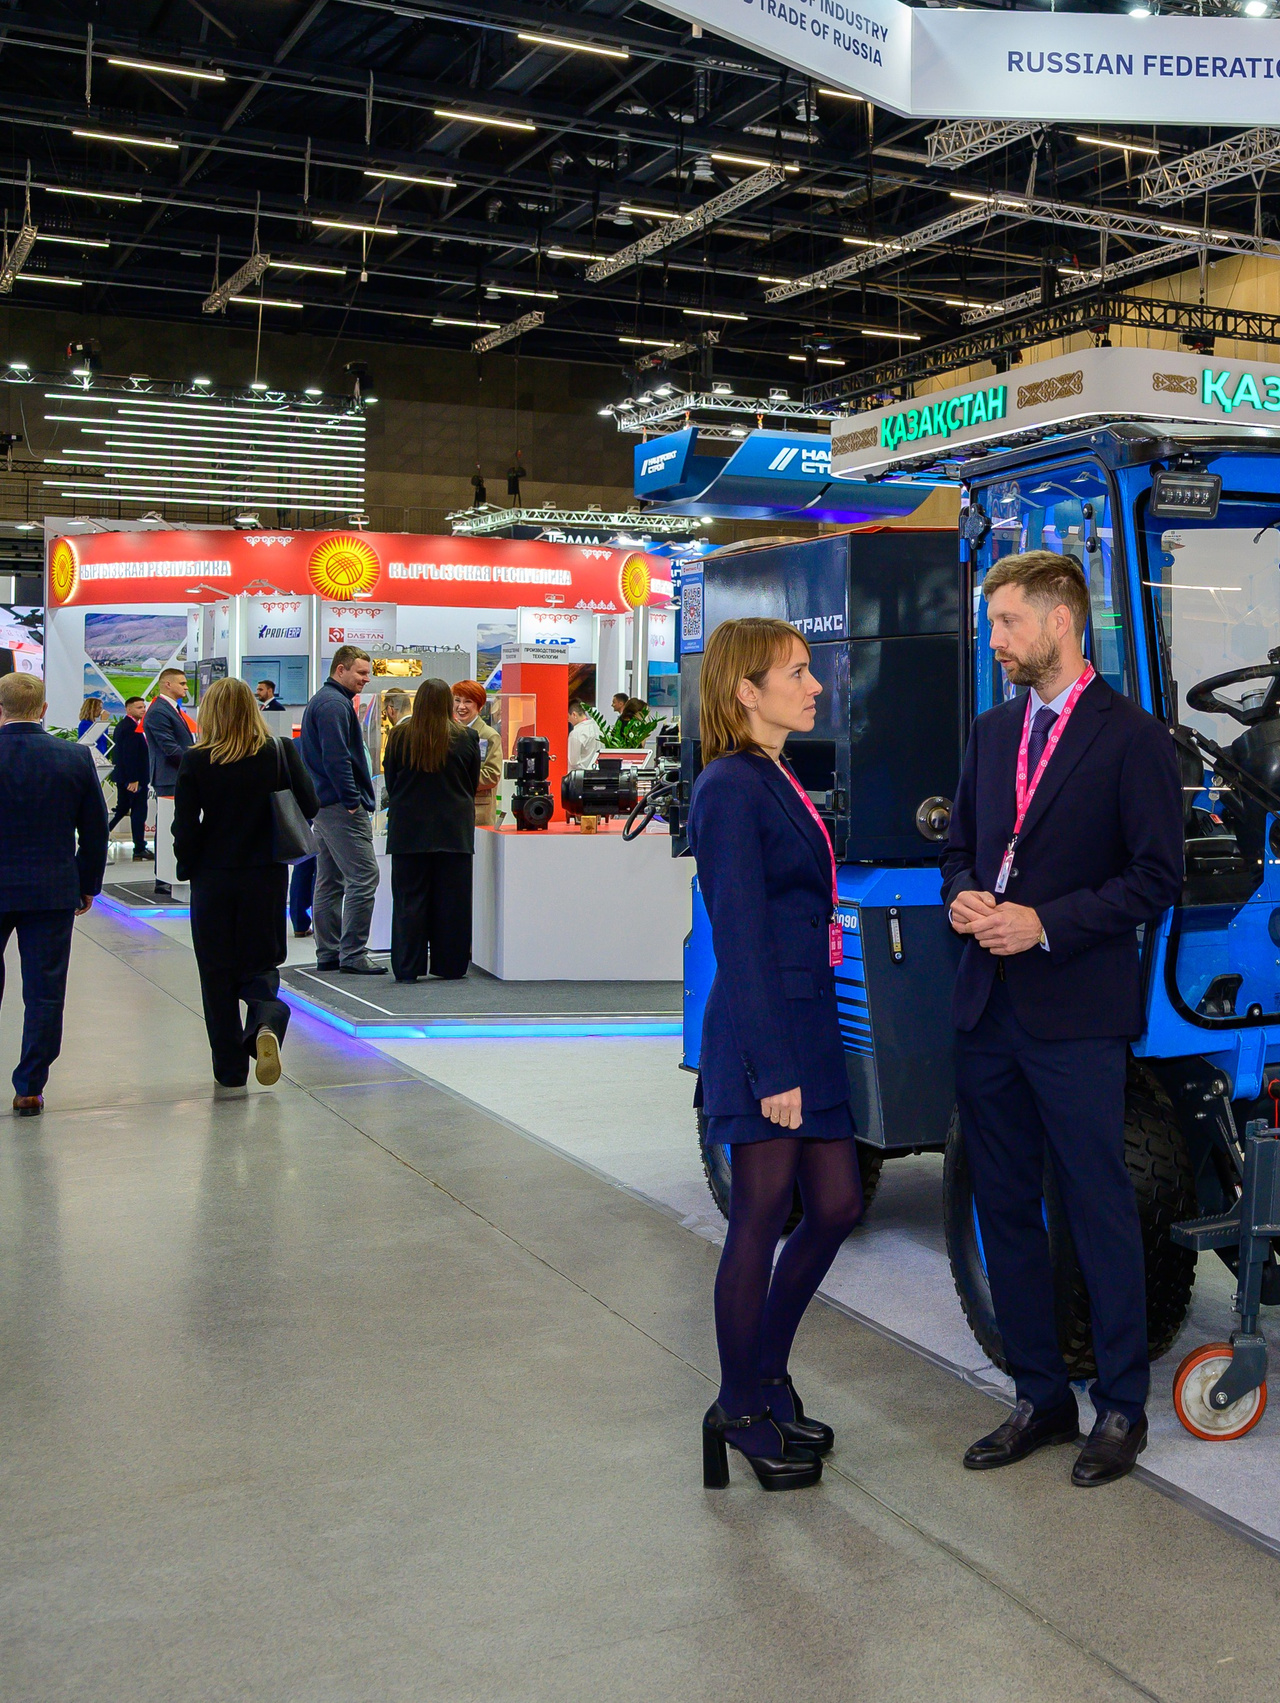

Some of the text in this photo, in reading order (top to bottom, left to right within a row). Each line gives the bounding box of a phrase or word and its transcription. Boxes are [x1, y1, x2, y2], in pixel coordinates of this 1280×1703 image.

[811, 19, 829, 41] OF
[833, 32, 882, 67] RUSSIA
[1007, 50, 1133, 76] RUSSIAN
[881, 385, 1008, 451] ҚАЗАҚСТАН
[389, 563, 491, 581] КЫРГЫЗСКАЯ
[347, 632, 384, 640] DASTAN
[789, 614, 843, 635] ТРАКС
